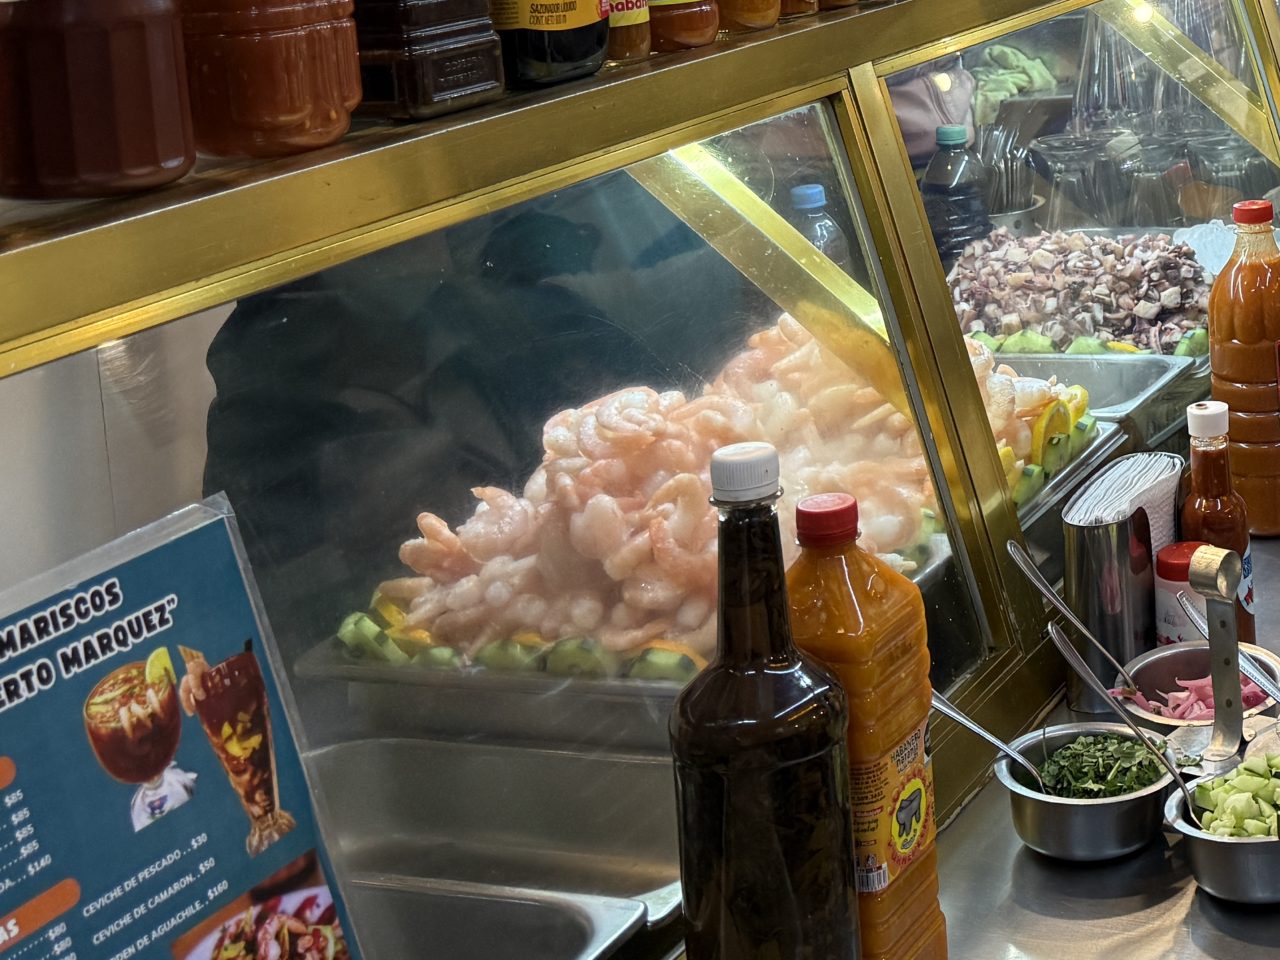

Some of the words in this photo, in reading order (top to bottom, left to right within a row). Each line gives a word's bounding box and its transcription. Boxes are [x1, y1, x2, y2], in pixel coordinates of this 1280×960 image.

[530, 2, 561, 15] SAZONADOR
[0, 578, 122, 660] MARISCOS
[4, 789, 24, 808] $85
[11, 807, 31, 826] $85
[15, 824, 35, 842] $85
[20, 840, 40, 858] $85
[82, 883, 124, 918] CEVICHE
[124, 876, 139, 892] DE
[138, 849, 182, 883] PESCADO
[92, 911, 134, 945] CEVICHE
[133, 904, 148, 920] DE
[110, 943, 136, 960] RDEN
[136, 934, 151, 950] DE
[151, 901, 202, 941] AGUACHILE
